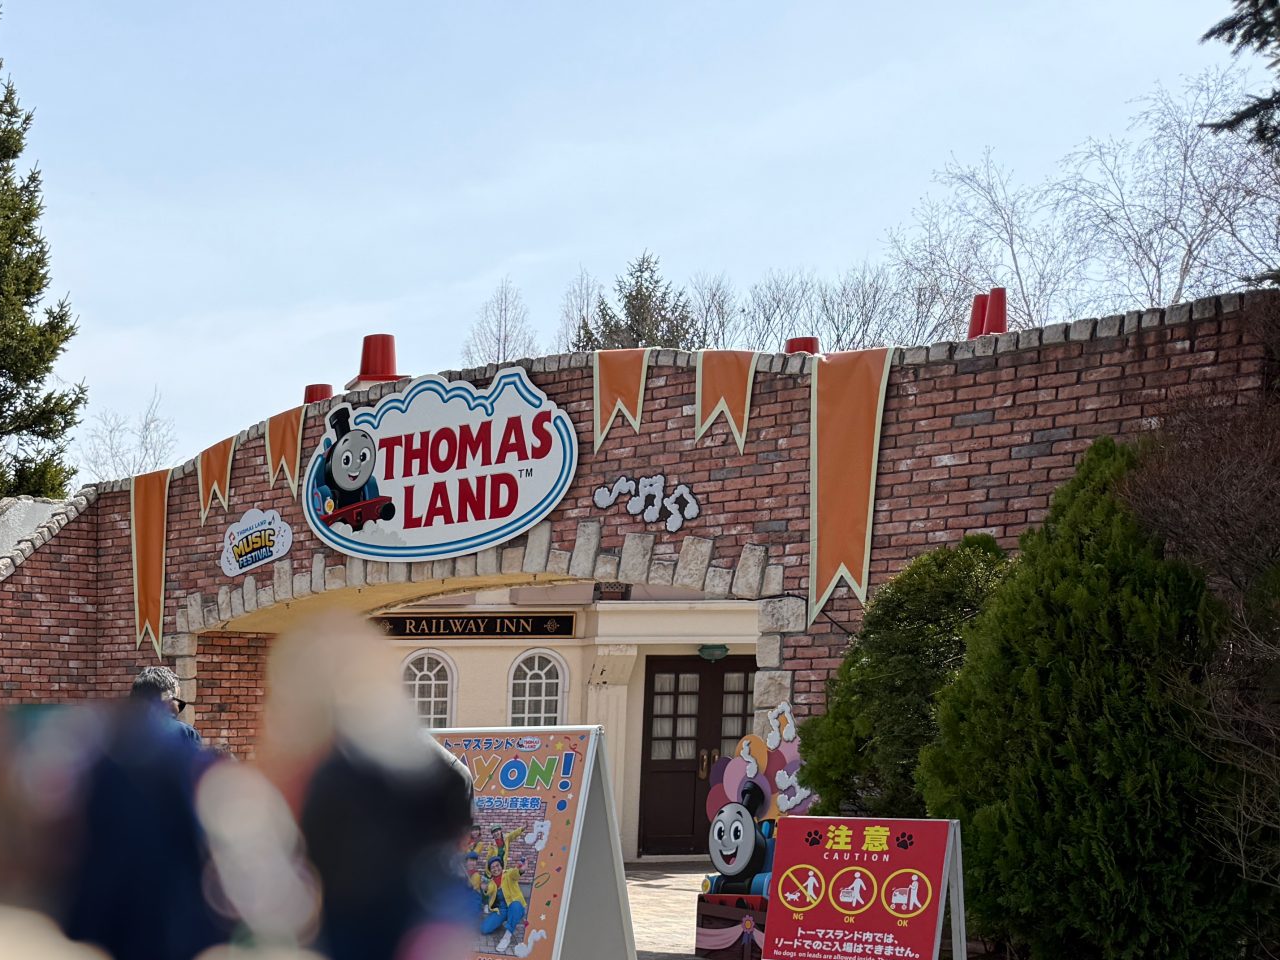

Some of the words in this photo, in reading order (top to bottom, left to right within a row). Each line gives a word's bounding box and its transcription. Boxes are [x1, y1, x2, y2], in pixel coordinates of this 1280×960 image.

[378, 410, 553, 480] THOMAS
[403, 472, 519, 529] LAND
[232, 529, 275, 562] MUSIC
[239, 547, 273, 569] FESTIVAL
[405, 618, 488, 634] RAILWAY
[496, 618, 533, 633] INN
[444, 738, 514, 751] トーマスランド
[825, 825, 891, 851] 注意
[823, 852, 890, 862] CAUTION
[897, 919, 909, 927] OK
[797, 927, 899, 944] トーマスランド内では、
[783, 950, 797, 958] dogs
